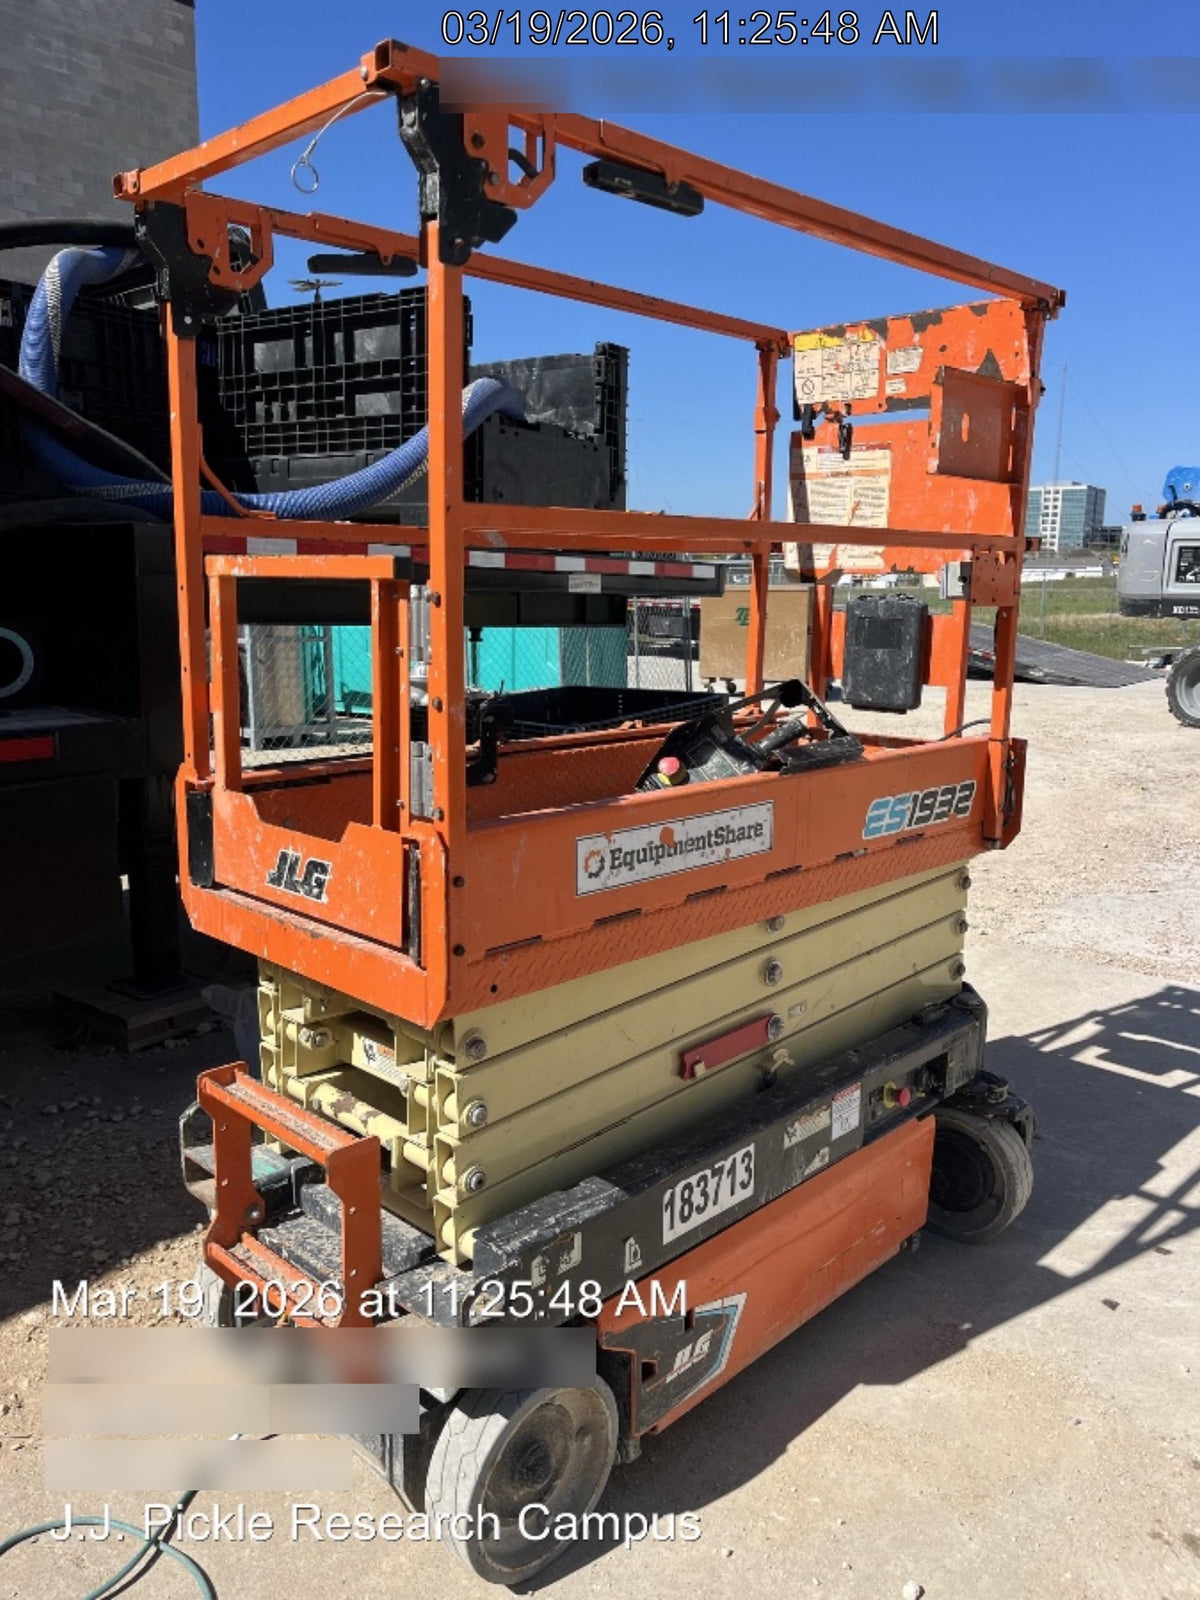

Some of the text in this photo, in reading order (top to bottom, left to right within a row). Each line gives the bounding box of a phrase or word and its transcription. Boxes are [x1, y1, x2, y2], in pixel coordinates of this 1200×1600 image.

[862, 780, 976, 839] ES1932
[609, 821, 764, 872] EquipmentShare
[265, 849, 333, 904] JLG
[664, 1149, 753, 1232] 183713
